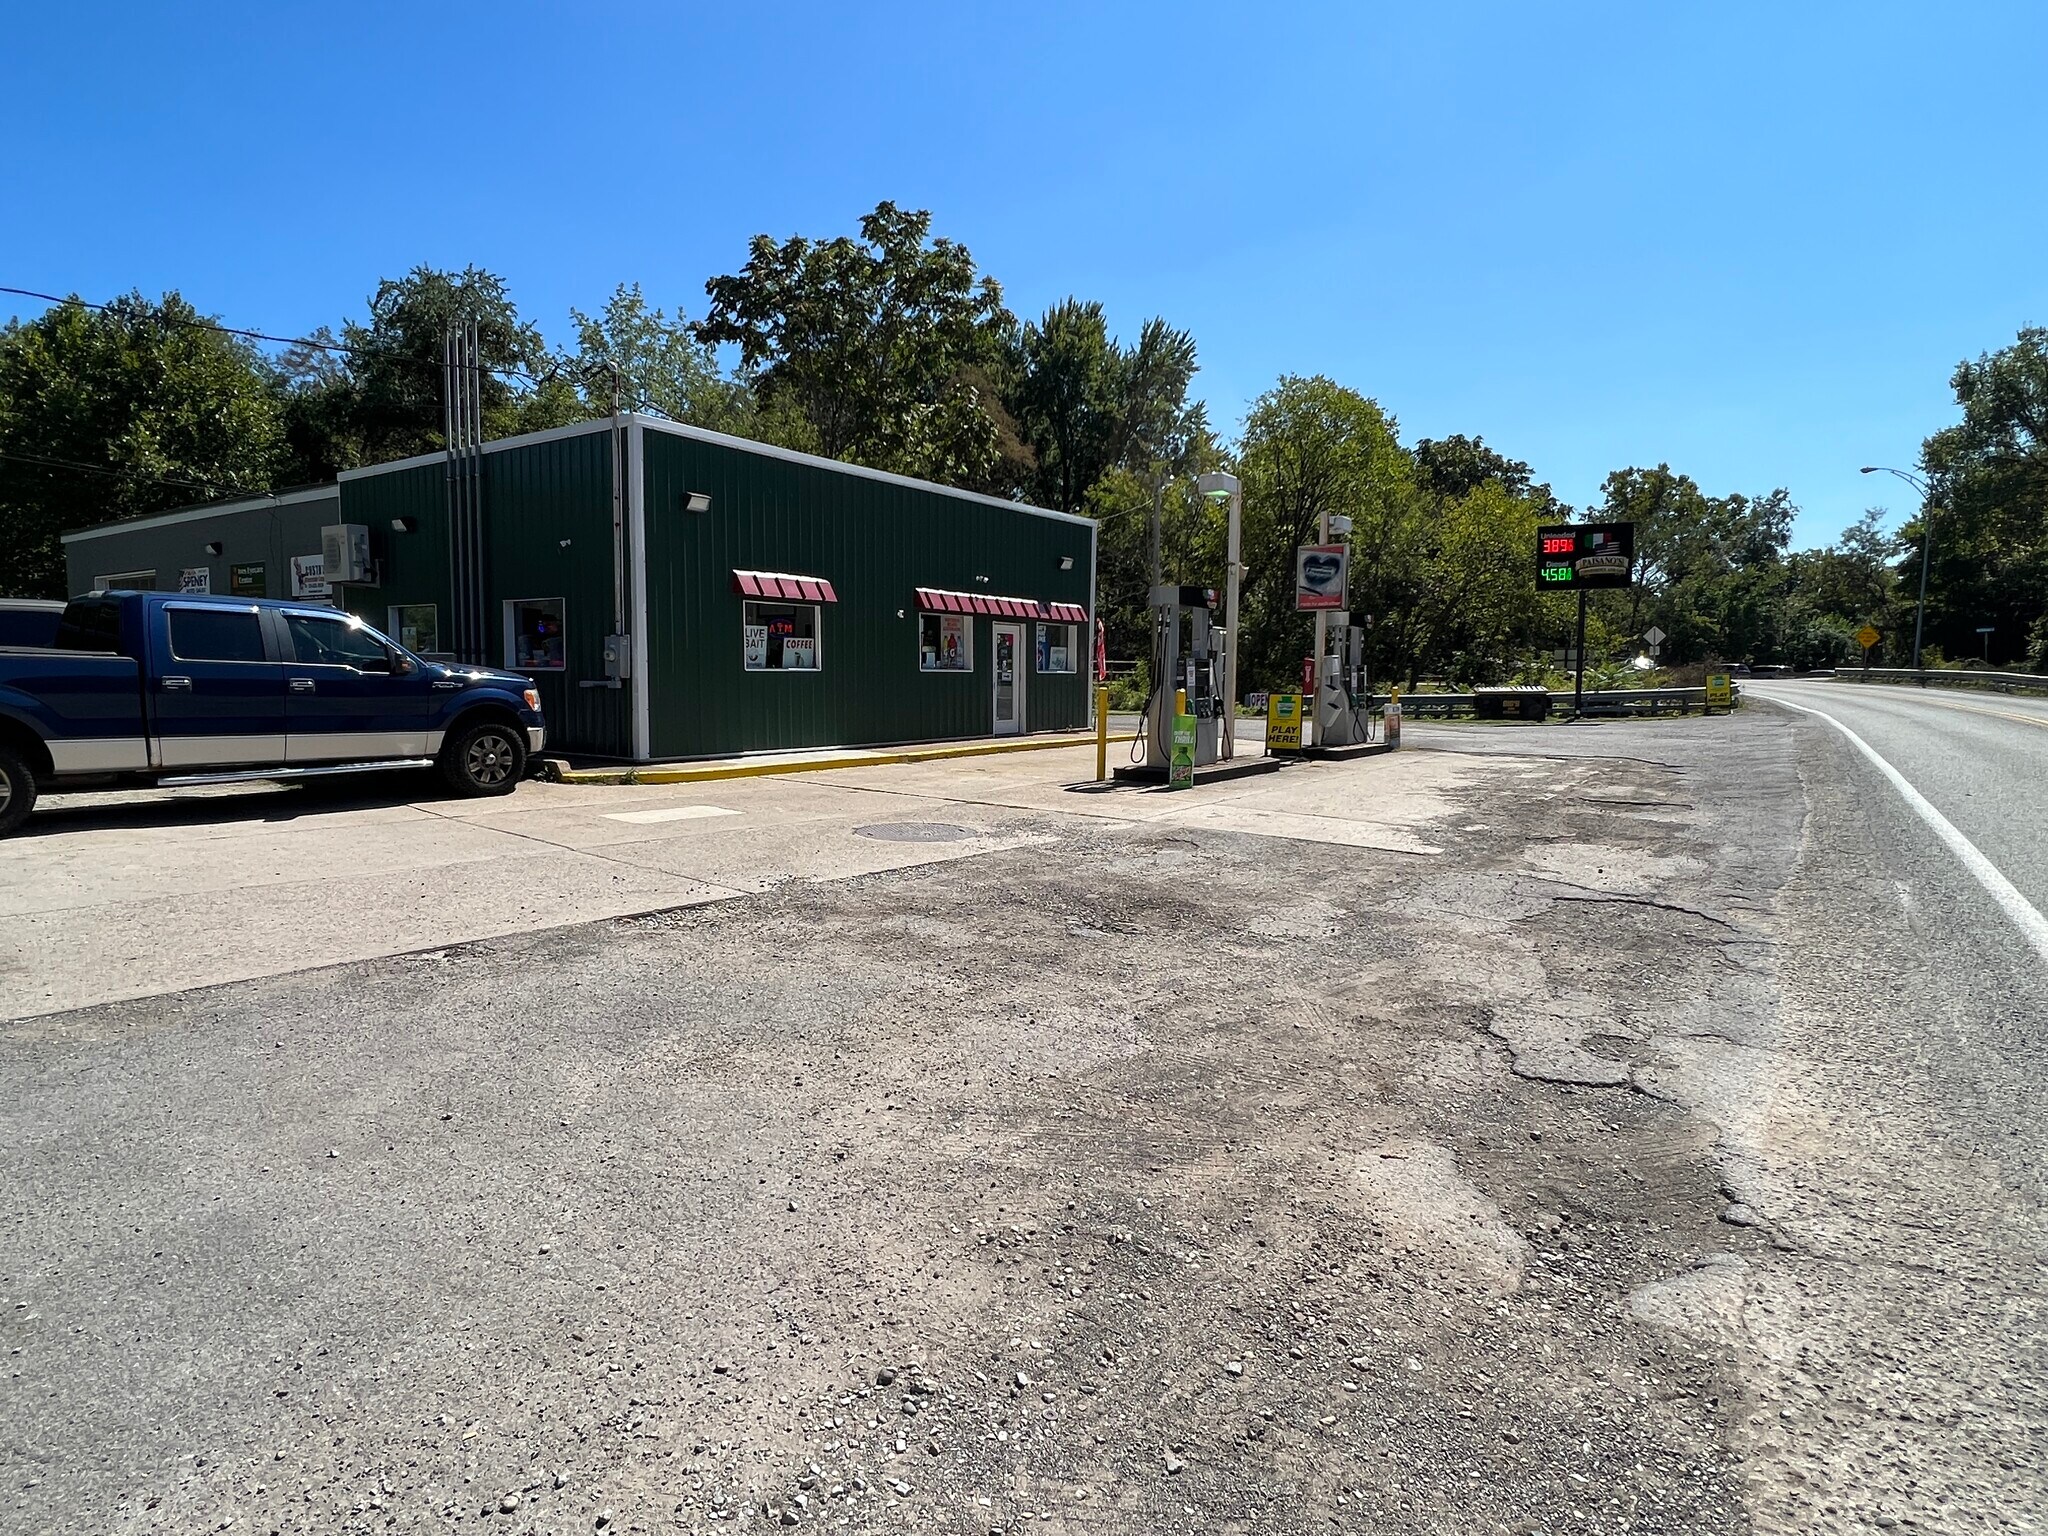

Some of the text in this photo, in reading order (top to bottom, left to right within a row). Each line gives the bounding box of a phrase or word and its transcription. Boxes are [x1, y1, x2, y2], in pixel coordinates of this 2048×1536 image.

[1540, 531, 1576, 540] Unleaded
[1582, 556, 1624, 566] PAISANO'S
[745, 628, 765, 638] LIVE
[769, 623, 793, 634] ATM
[786, 640, 812, 649] COFFEE
[1271, 725, 1298, 734] PLAY
[1269, 735, 1299, 743] HERE!
